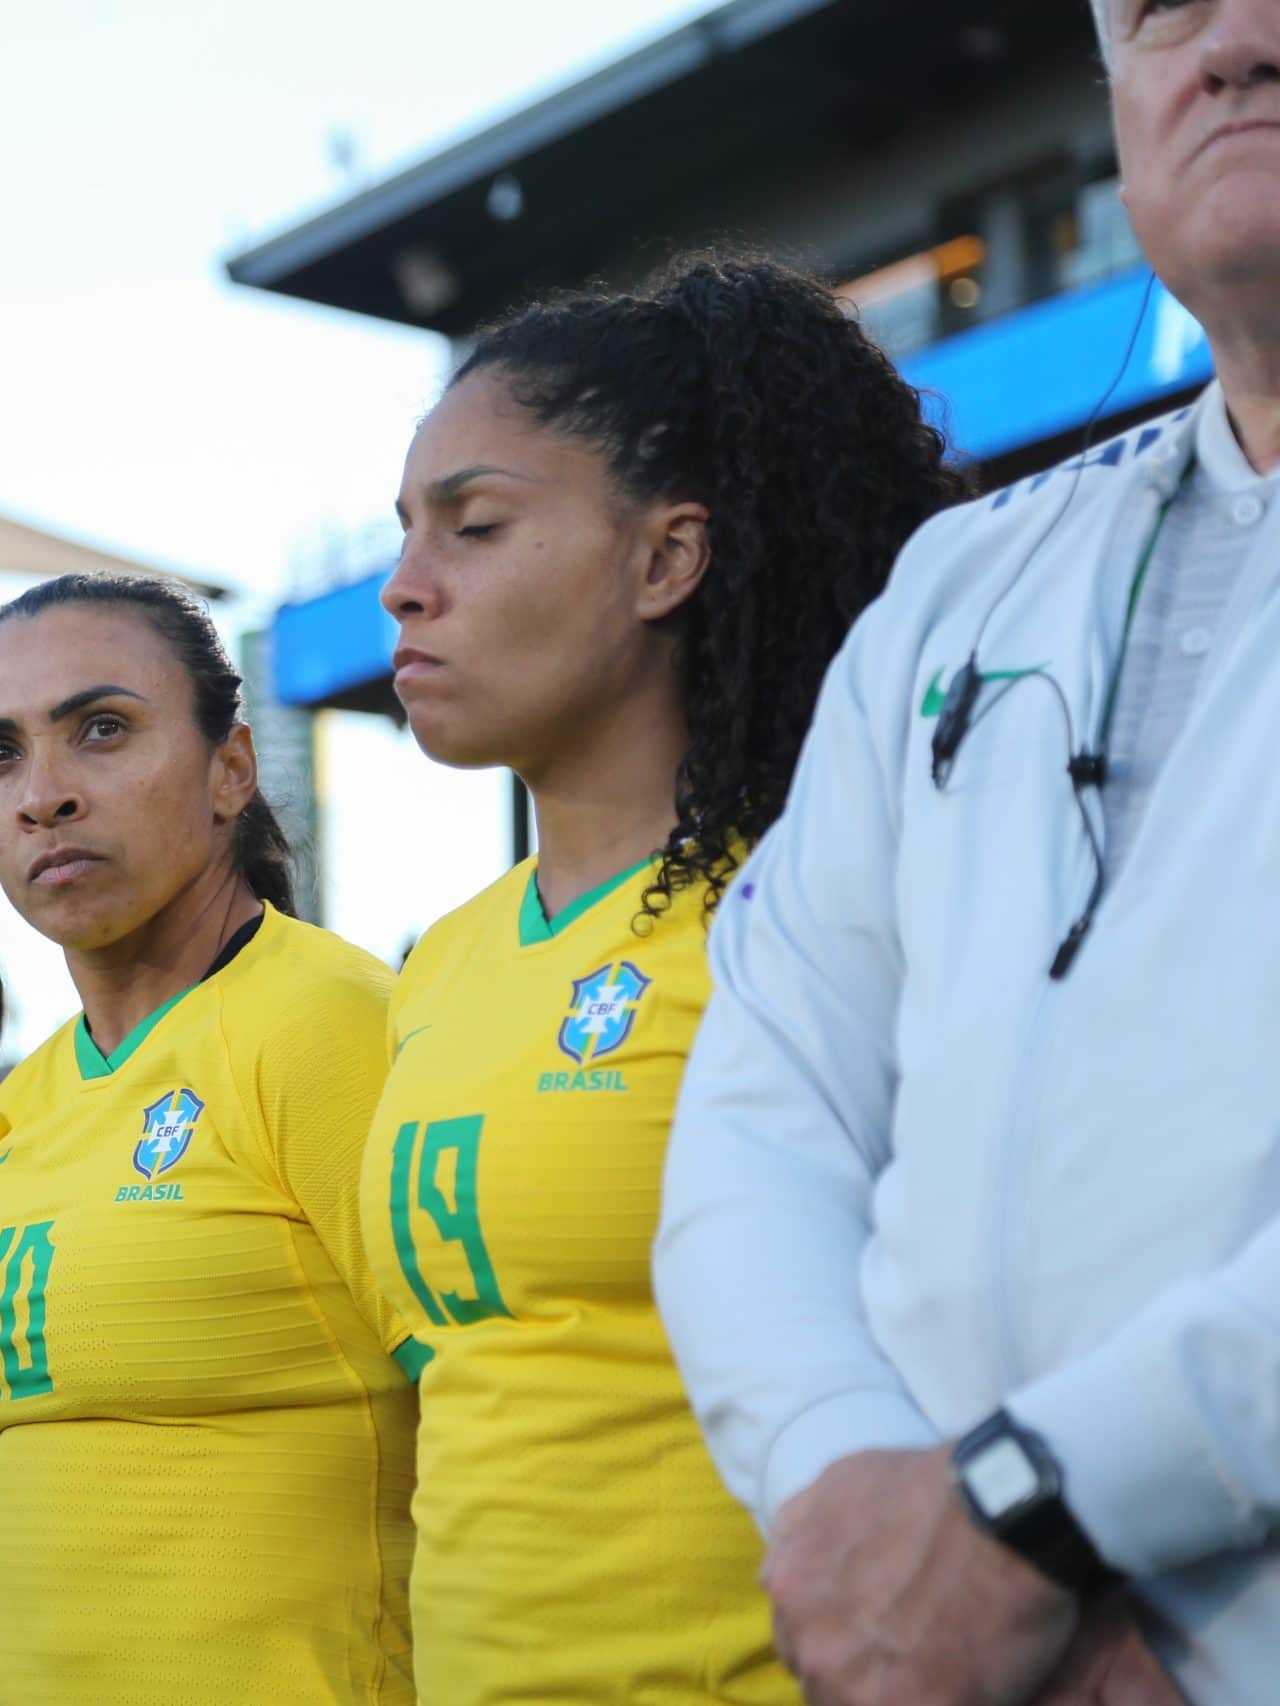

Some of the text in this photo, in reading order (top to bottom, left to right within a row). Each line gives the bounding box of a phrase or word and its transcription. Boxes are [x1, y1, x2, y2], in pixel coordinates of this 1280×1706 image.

[587, 1003, 616, 1016] CBF
[538, 1071, 629, 1091] BRASIL
[156, 1126, 179, 1137] CBF
[115, 1184, 184, 1202] BRASIL
[390, 1114, 517, 1326] 19
